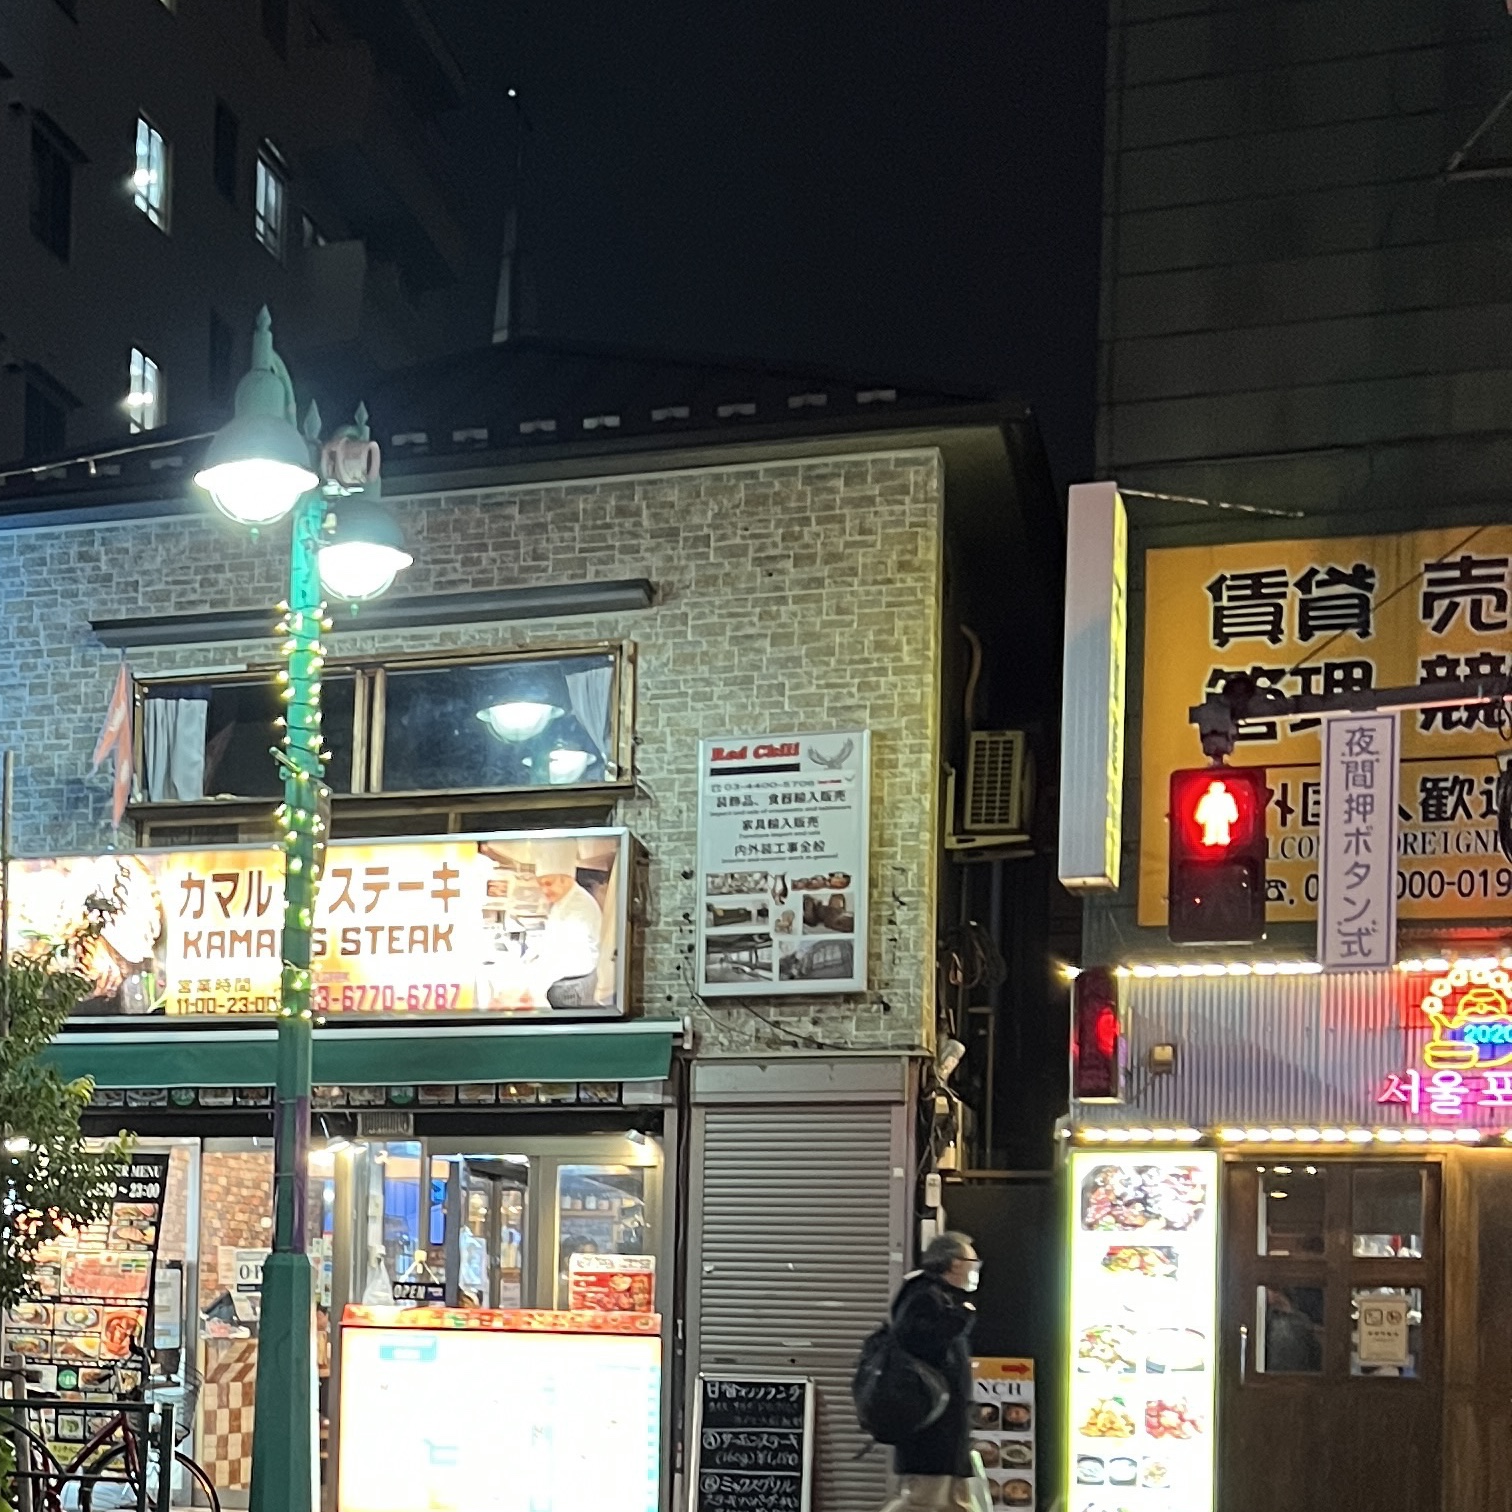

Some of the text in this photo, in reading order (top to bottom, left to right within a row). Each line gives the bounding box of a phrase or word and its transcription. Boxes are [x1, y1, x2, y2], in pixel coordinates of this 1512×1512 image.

[1206, 555, 1509, 648] 賃貸 売
[1340, 726, 1380, 958] 夜間押ボタン式
[179, 862, 460, 920] カマルステーキ
[341, 923, 454, 956] STEAK
[178, 978, 251, 994] 営業時間
[317, 984, 461, 1013] 3-6770-6787
[131, 1165, 161, 1178] MENU
[393, 1284, 426, 1300] OPEN
